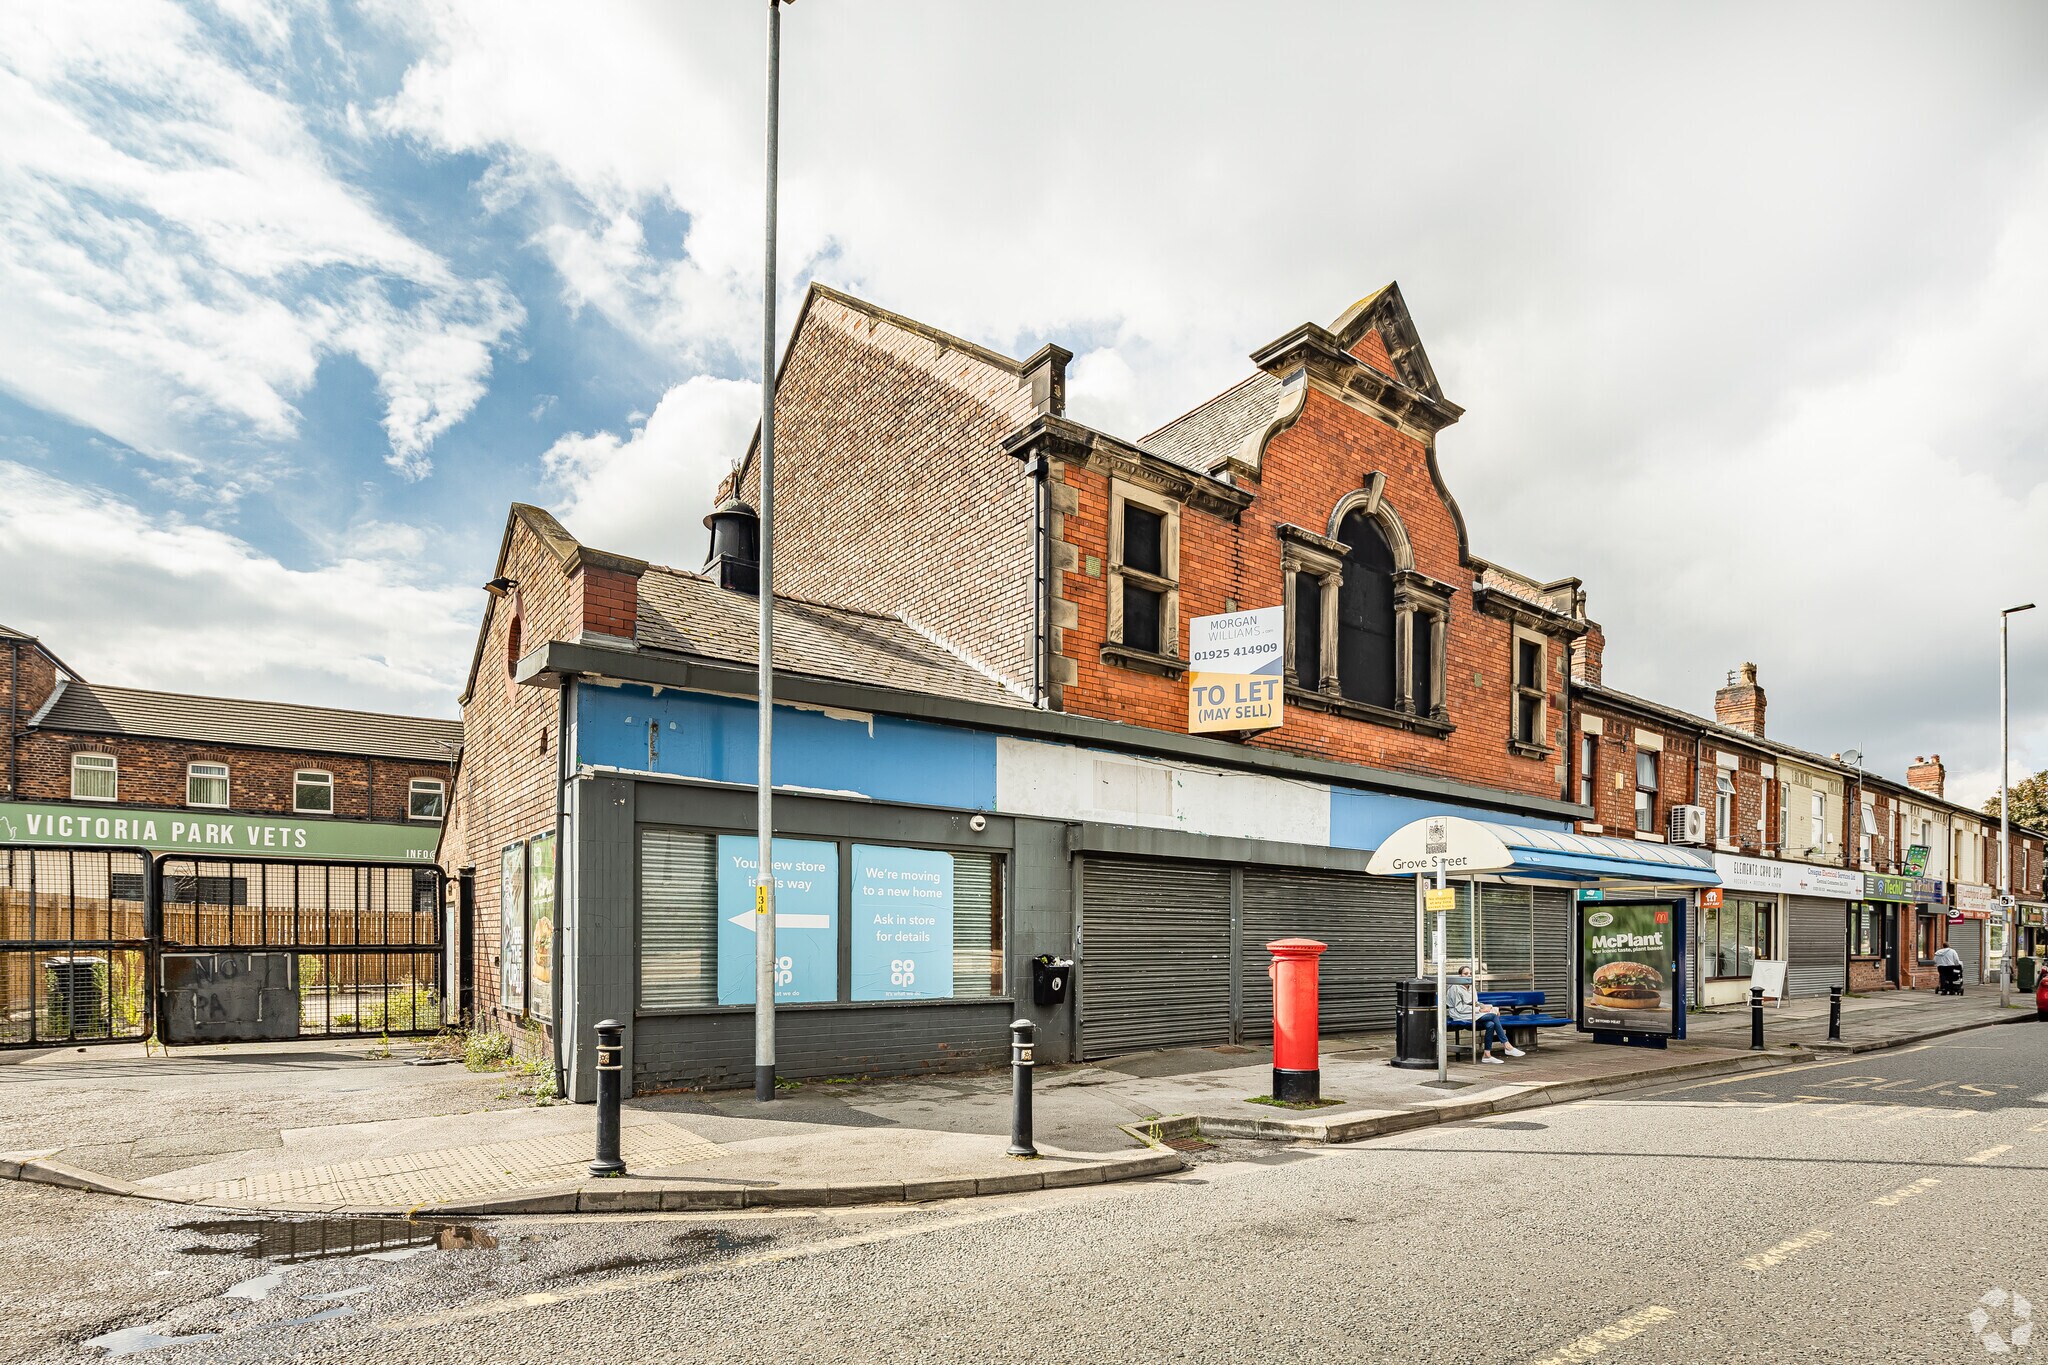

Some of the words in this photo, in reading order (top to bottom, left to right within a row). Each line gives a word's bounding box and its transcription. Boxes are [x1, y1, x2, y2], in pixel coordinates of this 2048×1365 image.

[1210, 616, 1257, 631] MORGAN
[1194, 649, 1230, 661] 01925
[1233, 642, 1278, 657] 414909
[1192, 685, 1226, 707] TO
[1235, 680, 1279, 704] LET
[1198, 708, 1231, 723] (MAY
[1235, 703, 1272, 719] SELL)
[26, 814, 158, 841] VICTORIA
[172, 821, 235, 845] PARK
[247, 825, 307, 848] VETS
[733, 856, 757, 869] You
[771, 861, 792, 872] ew
[795, 861, 826, 872] store
[1392, 858, 1427, 870] Grove
[1431, 855, 1468, 867] Sreet
[1733, 861, 1758, 876] ELEMENTS
[1760, 864, 1771, 878] CRYO
[1773, 866, 1782, 879] SPA
[774, 877, 783, 888] is
[787, 880, 812, 892] way
[901, 871, 941, 884] moving
[863, 886, 875, 896] to
[877, 888, 884, 896] a
[887, 888, 910, 897] new
[912, 886, 943, 898] home
[873, 914, 894, 925] Ask
[896, 914, 906, 925] in
[909, 916, 936, 925] store
[876, 930, 892, 941] for
[895, 931, 930, 942] details
[1802, 1076, 2019, 1097] BUS
